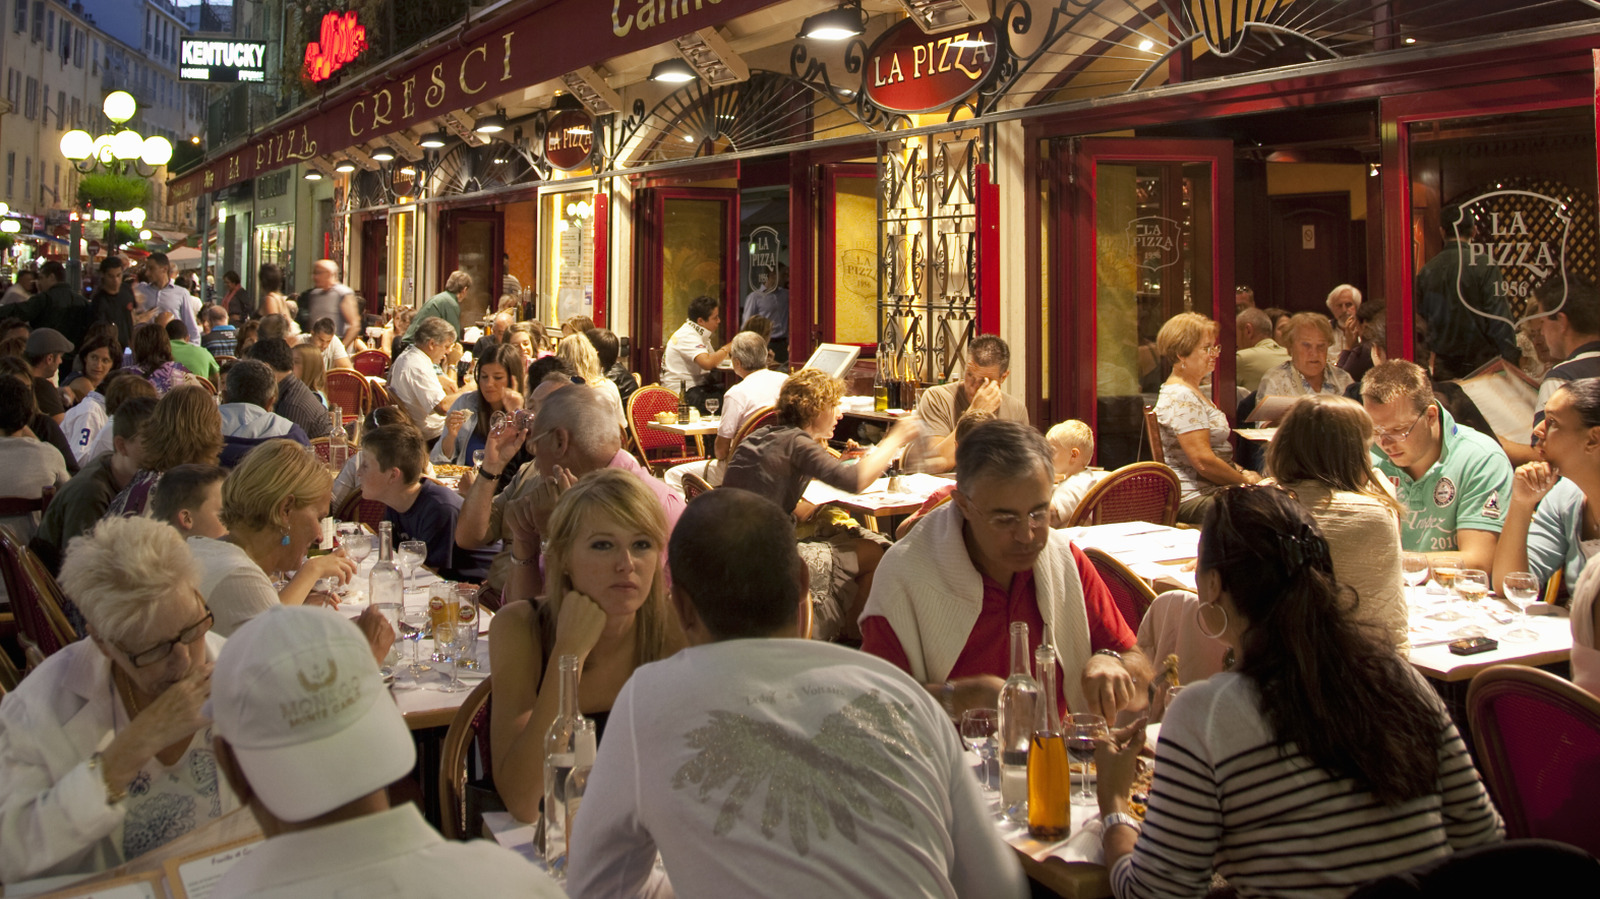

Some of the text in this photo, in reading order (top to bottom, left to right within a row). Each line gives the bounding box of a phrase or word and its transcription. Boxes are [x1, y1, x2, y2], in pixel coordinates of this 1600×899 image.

[611, 0, 721, 37] Can
[181, 41, 266, 68] KENTUCKY
[875, 31, 991, 87] LA PIZZA
[229, 156, 240, 180] LA
[255, 125, 317, 170] PIZZA
[350, 32, 514, 136] CRESCI
[548, 125, 593, 154] LA PIZZA
[1144, 225, 1162, 235] LA
[1490, 211, 1528, 235] LA
[758, 237, 769, 250] LA
[1133, 236, 1173, 251] PIZZA
[752, 252, 775, 272] PIZZA
[857, 256, 871, 266] LA
[1468, 241, 1554, 278] PIZZA
[847, 265, 877, 281] PIZZ
[1493, 281, 1528, 297] 1956
[79, 428, 91, 446] 3
